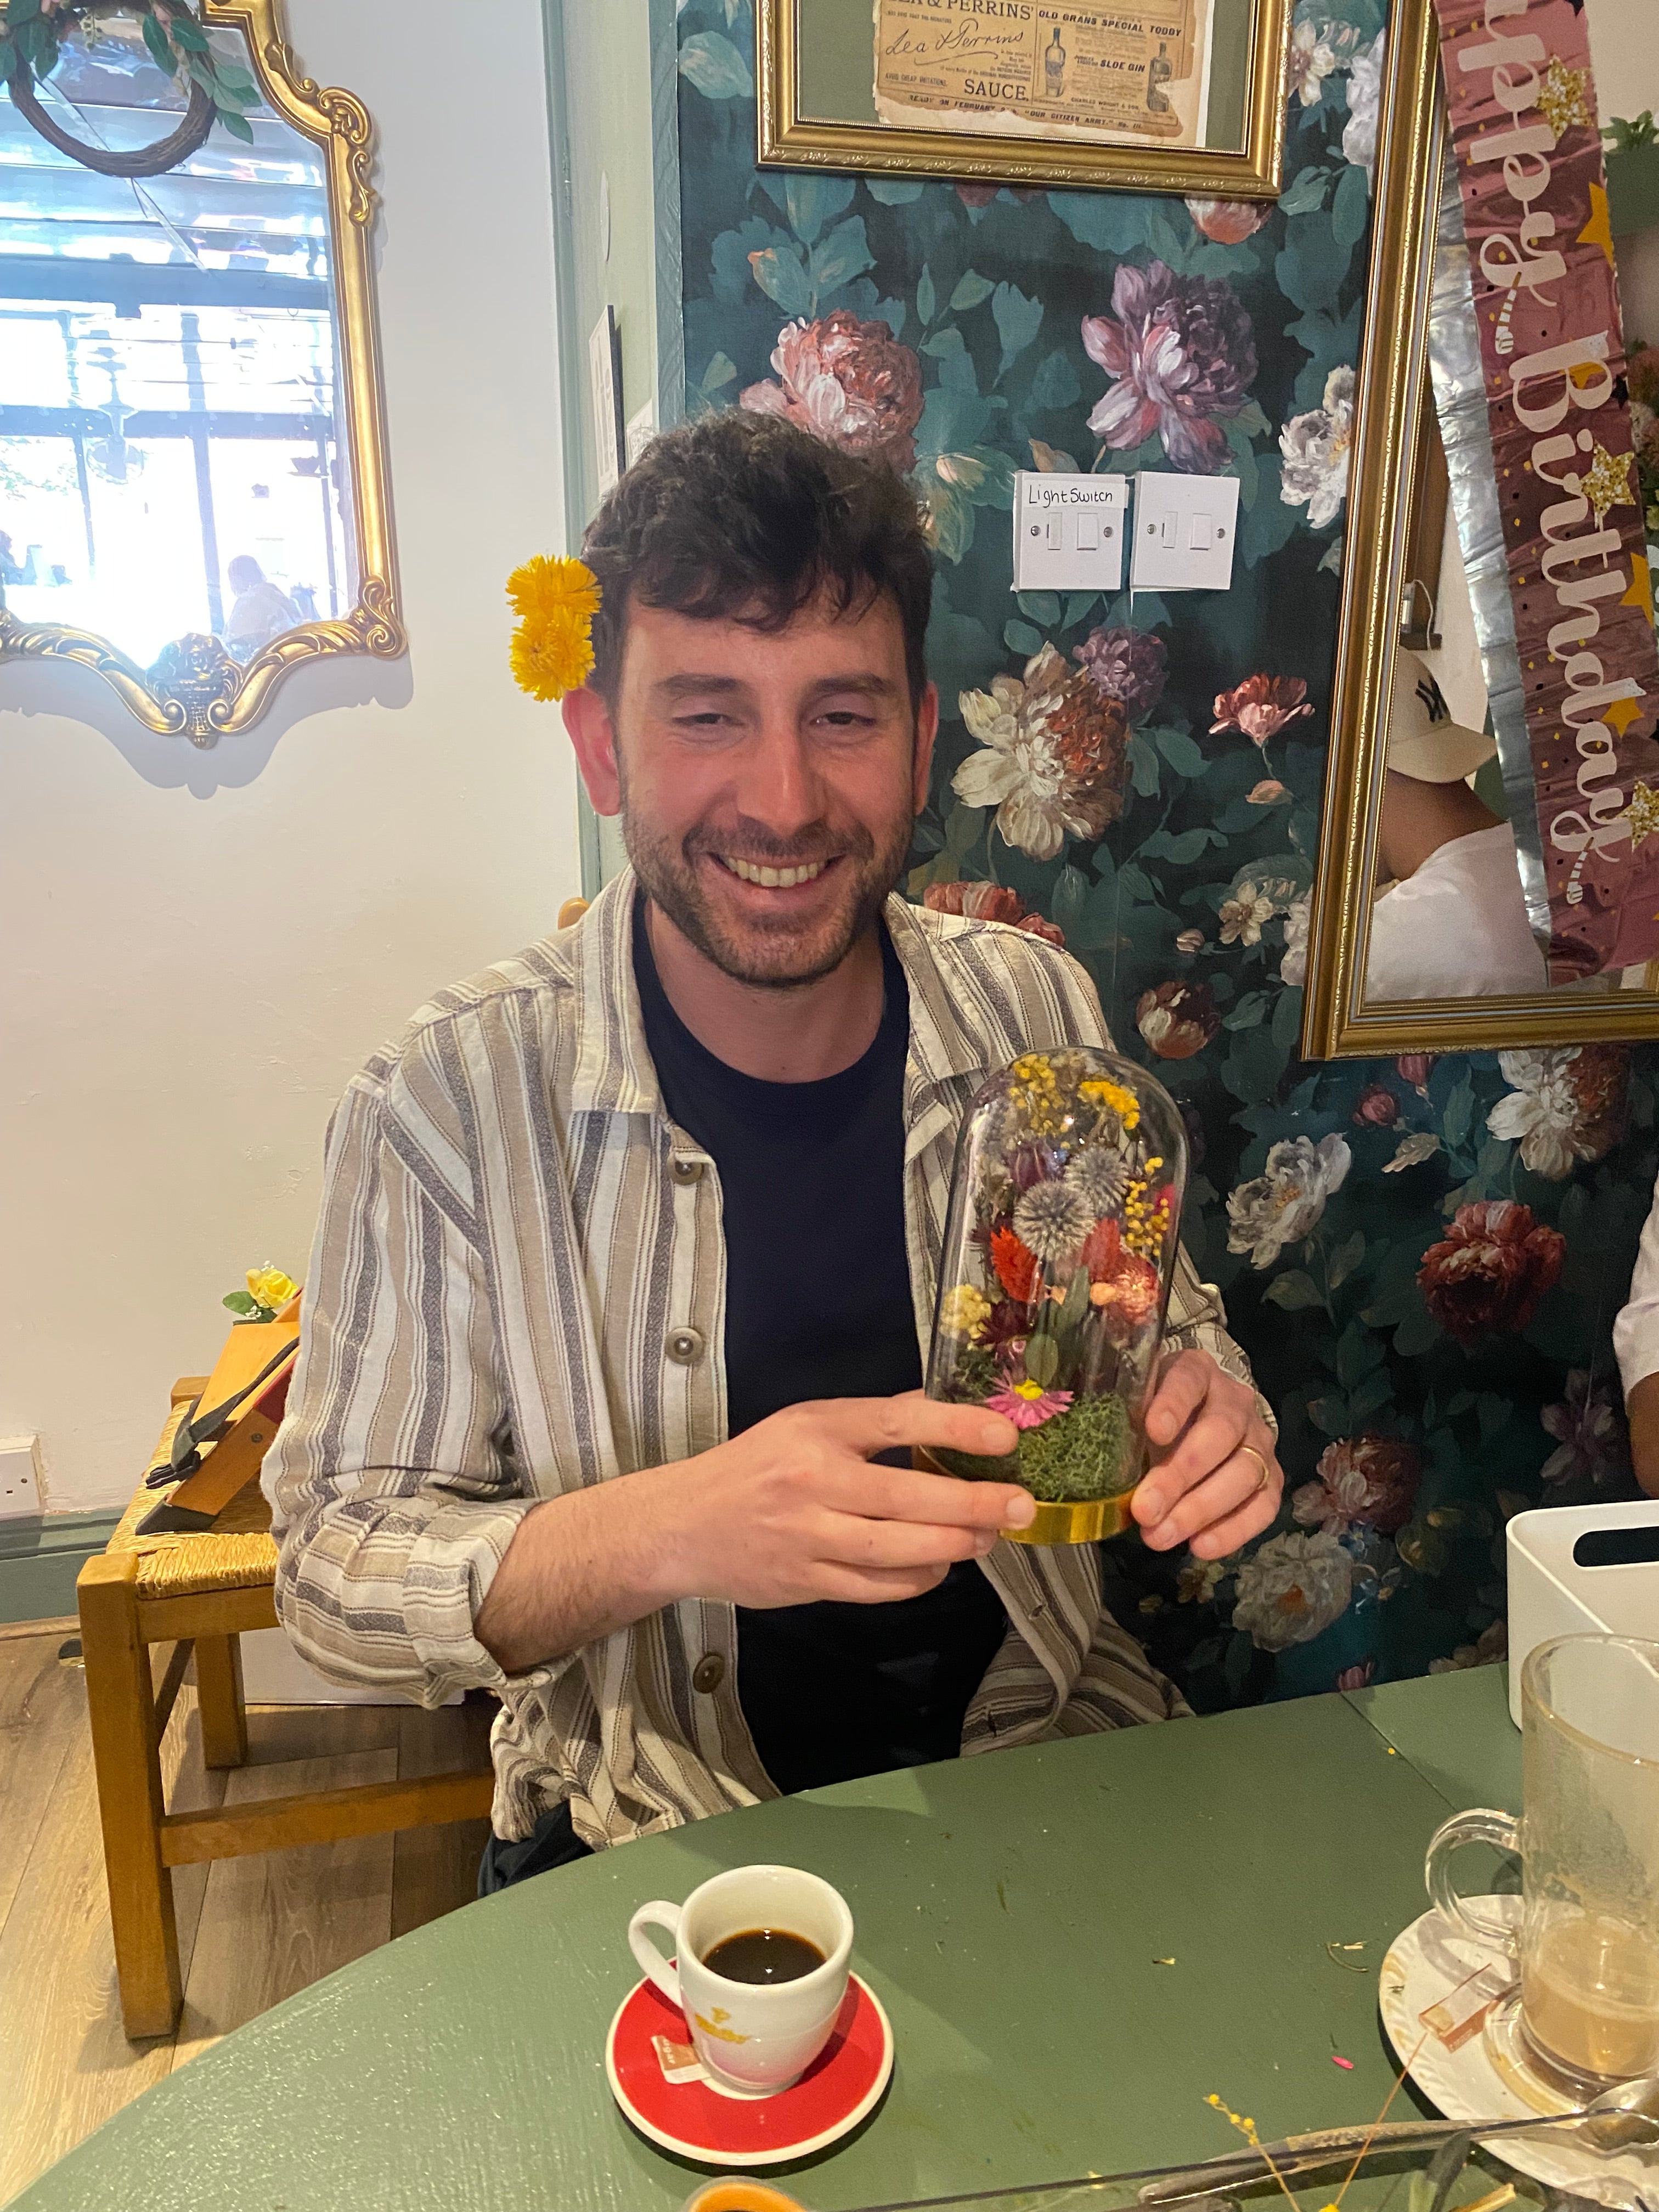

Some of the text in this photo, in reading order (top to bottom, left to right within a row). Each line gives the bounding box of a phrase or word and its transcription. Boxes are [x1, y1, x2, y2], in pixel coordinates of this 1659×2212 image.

[885, 29, 927, 55] Lea
[949, 18, 1024, 49] Perrins
[1039, 10, 1058, 19] OLD
[1101, 19, 1144, 33] SPECIAL
[1150, 25, 1182, 37] TODDY
[1100, 59, 1125, 70] SLOE
[1128, 64, 1146, 73] GIN
[1051, 113, 1080, 123] CITIZEN
[1509, 330, 1647, 862] Birthday
[662, 2038, 676, 2064] ugar
